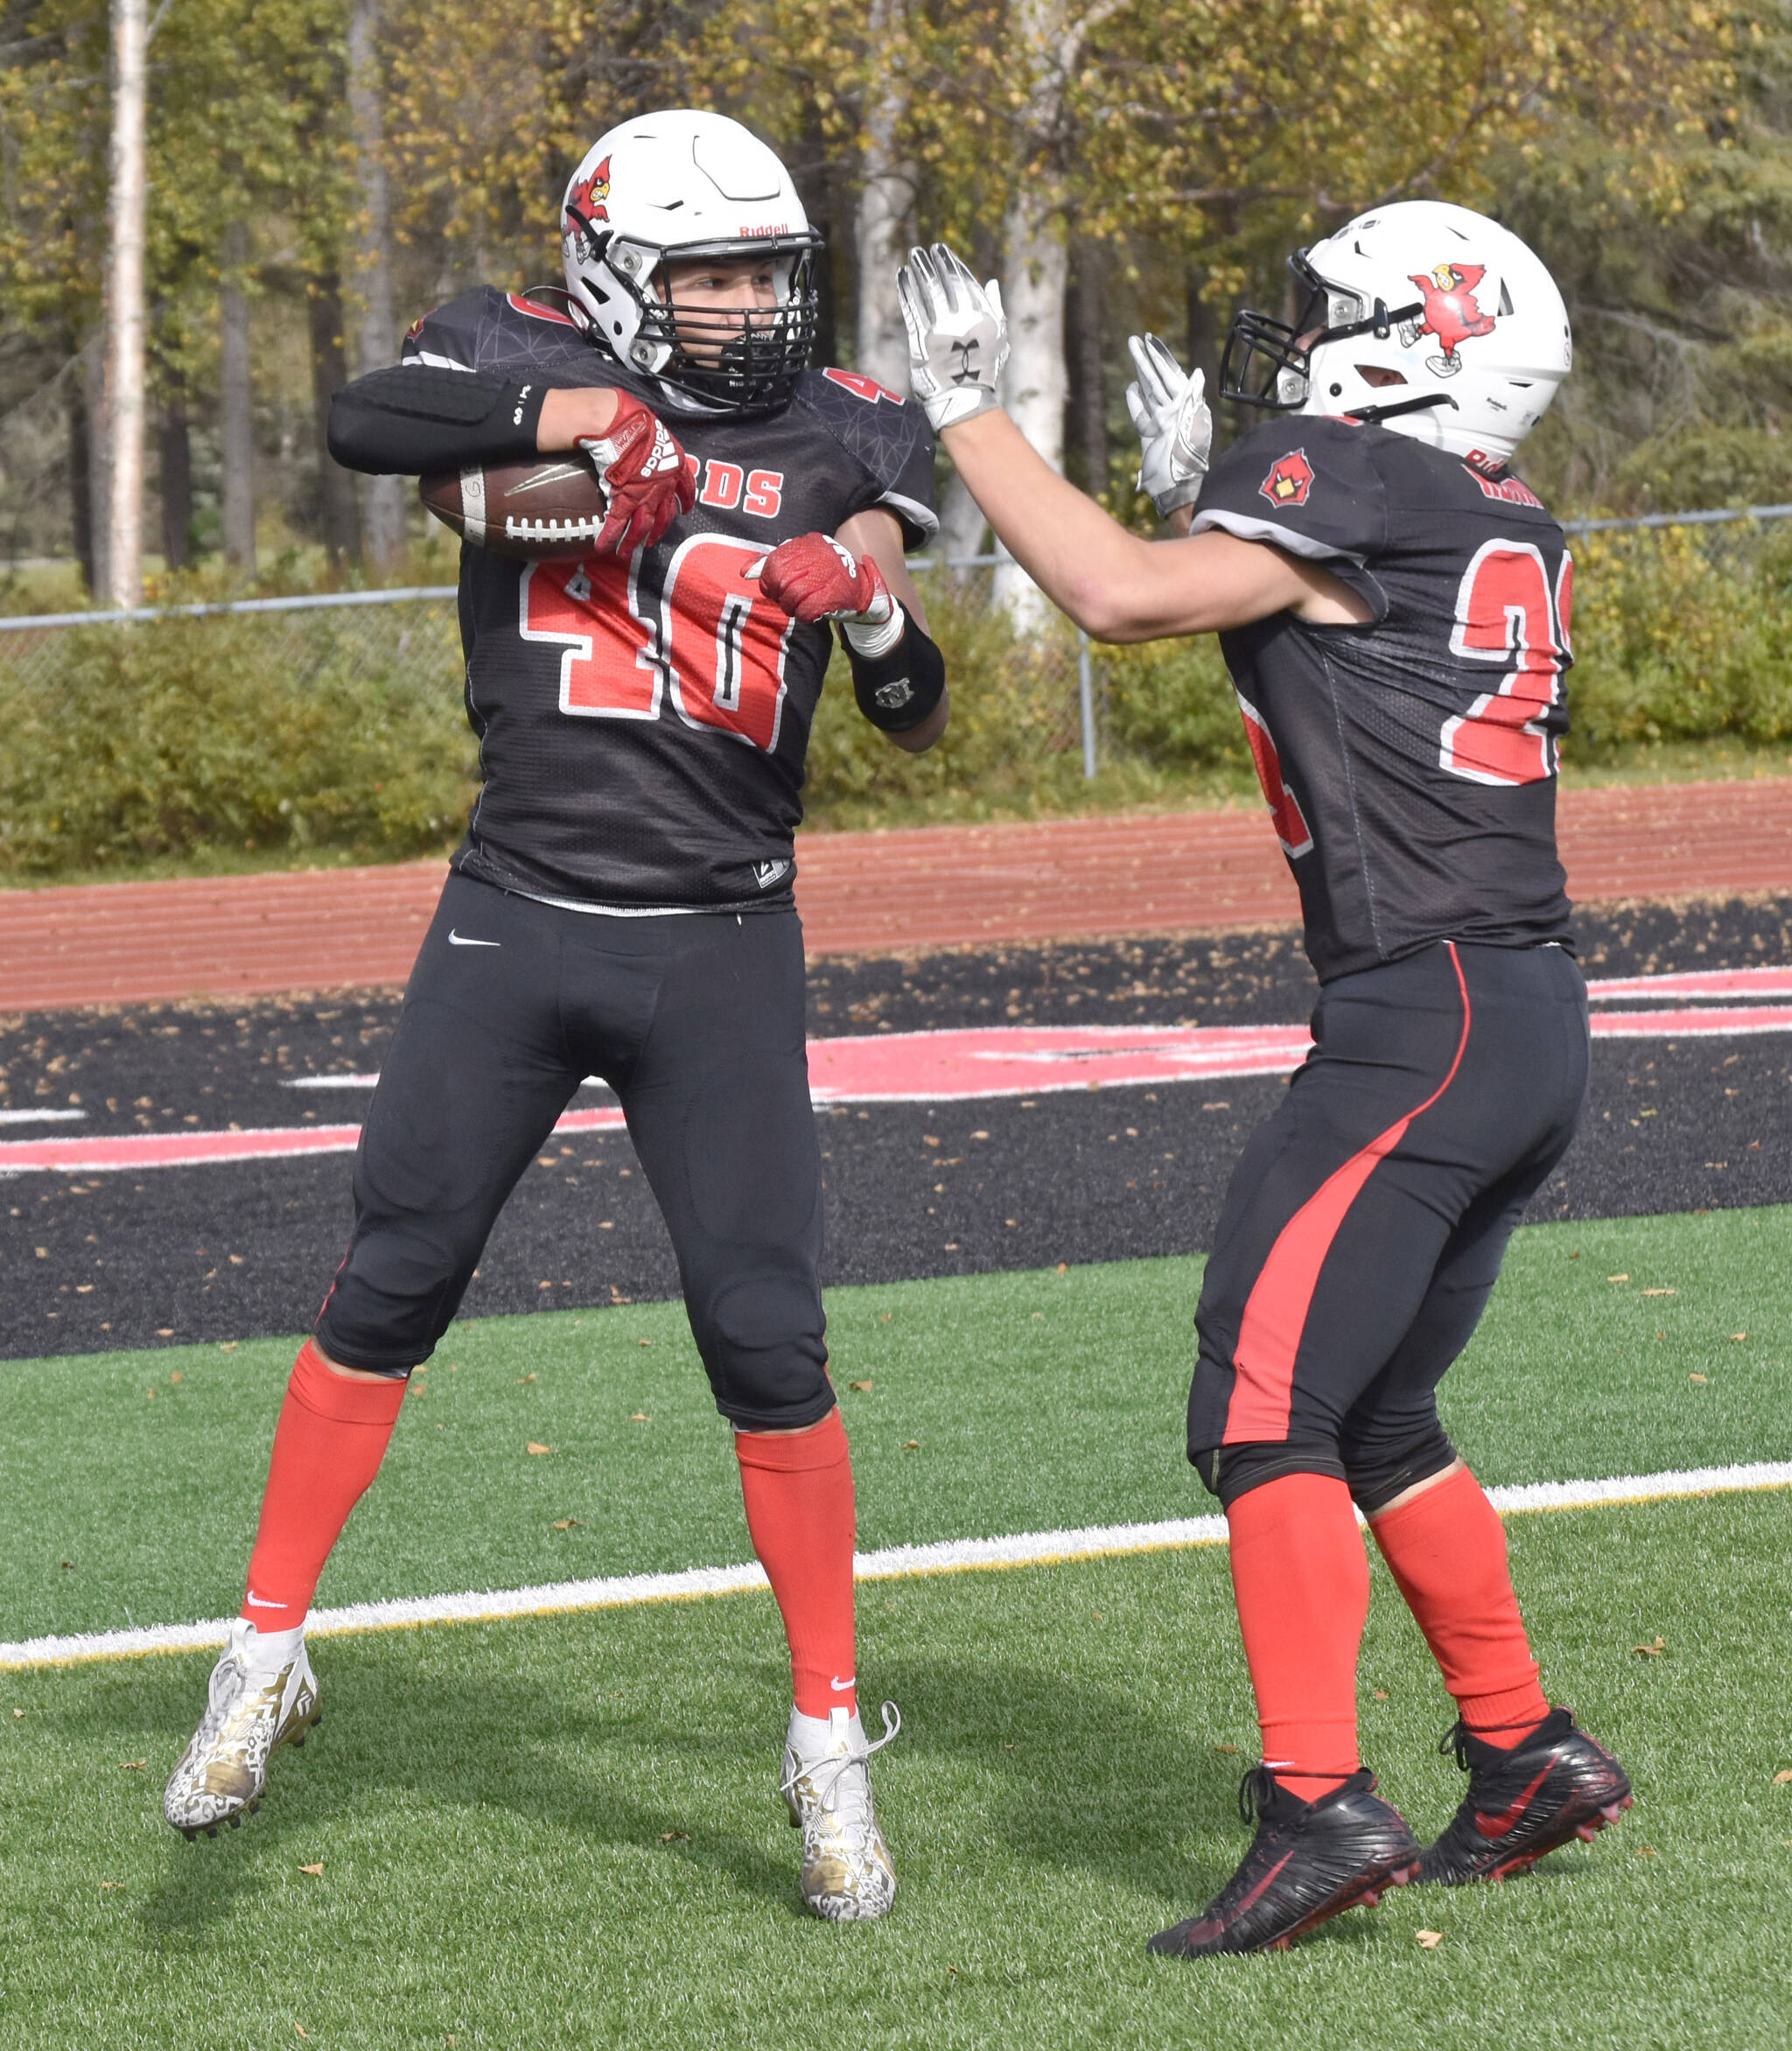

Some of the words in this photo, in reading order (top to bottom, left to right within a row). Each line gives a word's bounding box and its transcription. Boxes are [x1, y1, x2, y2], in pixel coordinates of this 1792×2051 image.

[738, 223, 788, 238] Riddell
[822, 367, 906, 406] 4
[519, 532, 795, 754] 40
